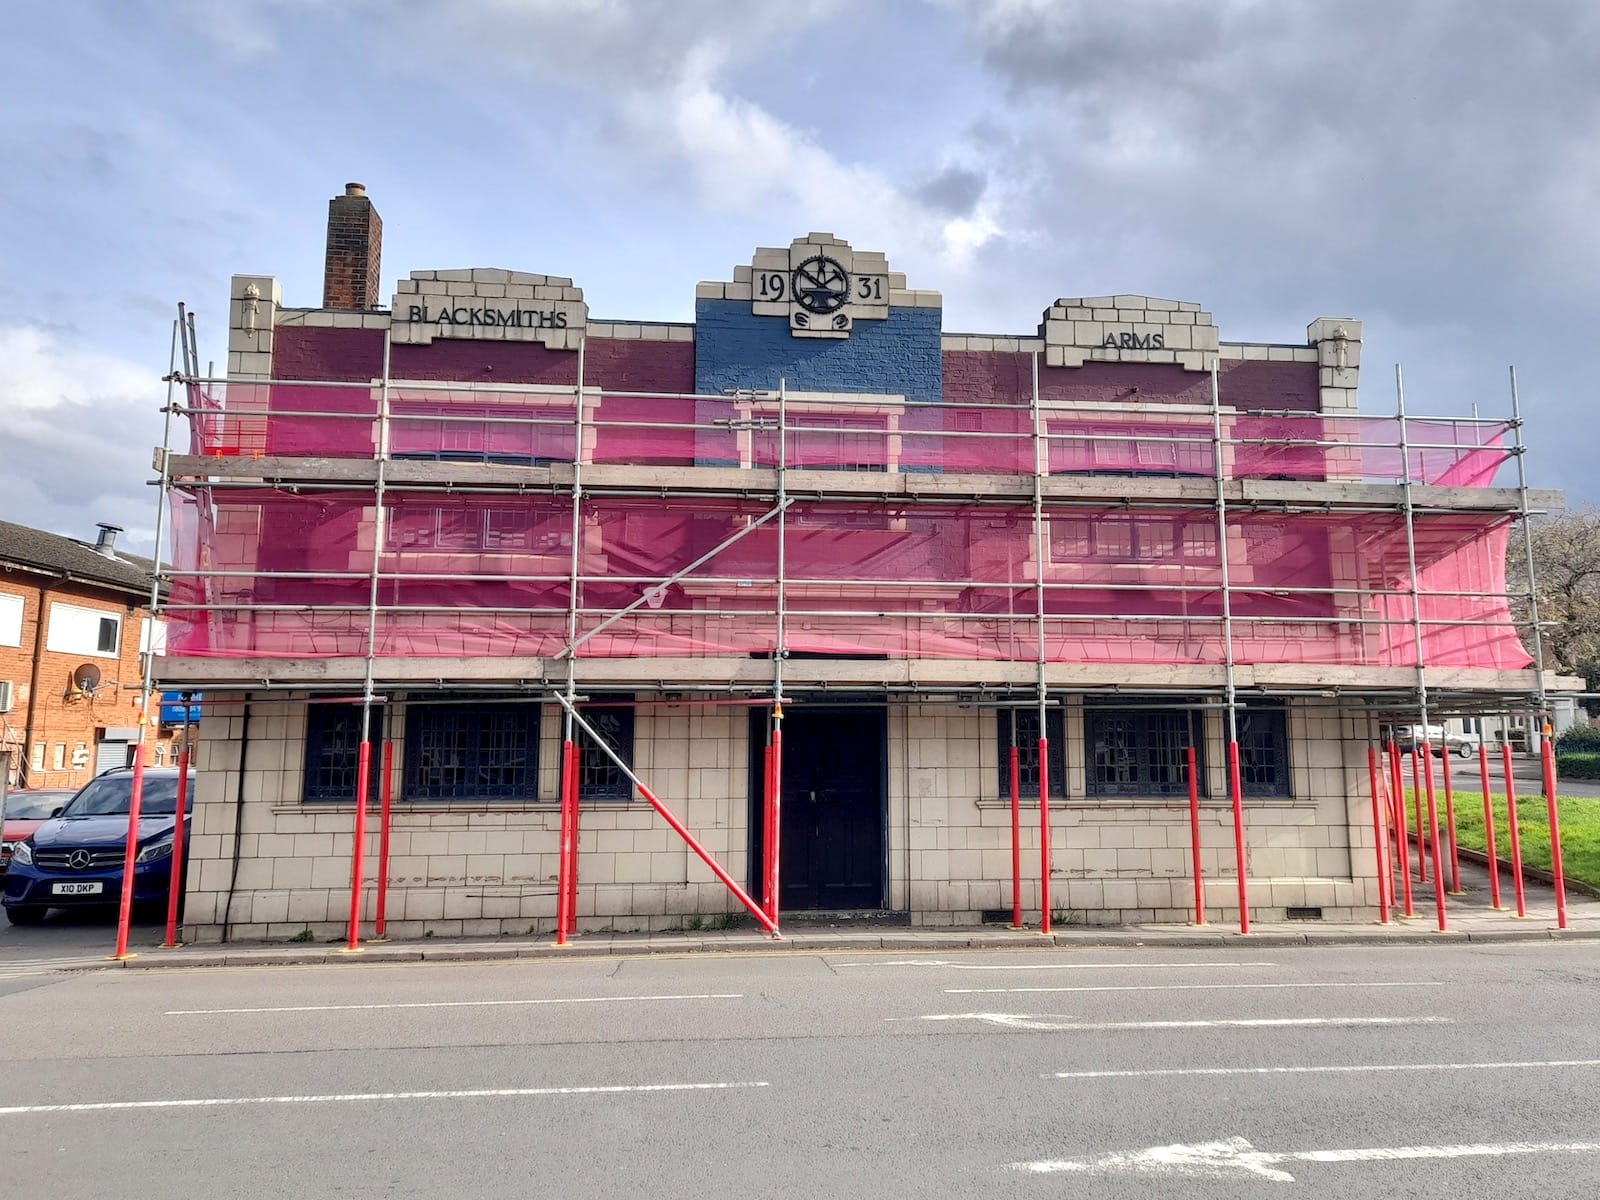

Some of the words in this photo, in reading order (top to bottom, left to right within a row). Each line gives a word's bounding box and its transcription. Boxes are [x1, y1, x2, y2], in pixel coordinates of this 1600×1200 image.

[760, 273, 785, 302] 19
[858, 277, 882, 299] 31
[408, 305, 567, 328] BLACKSMITHS
[1103, 332, 1164, 349] ARMS
[77, 883, 95, 893] DKP
